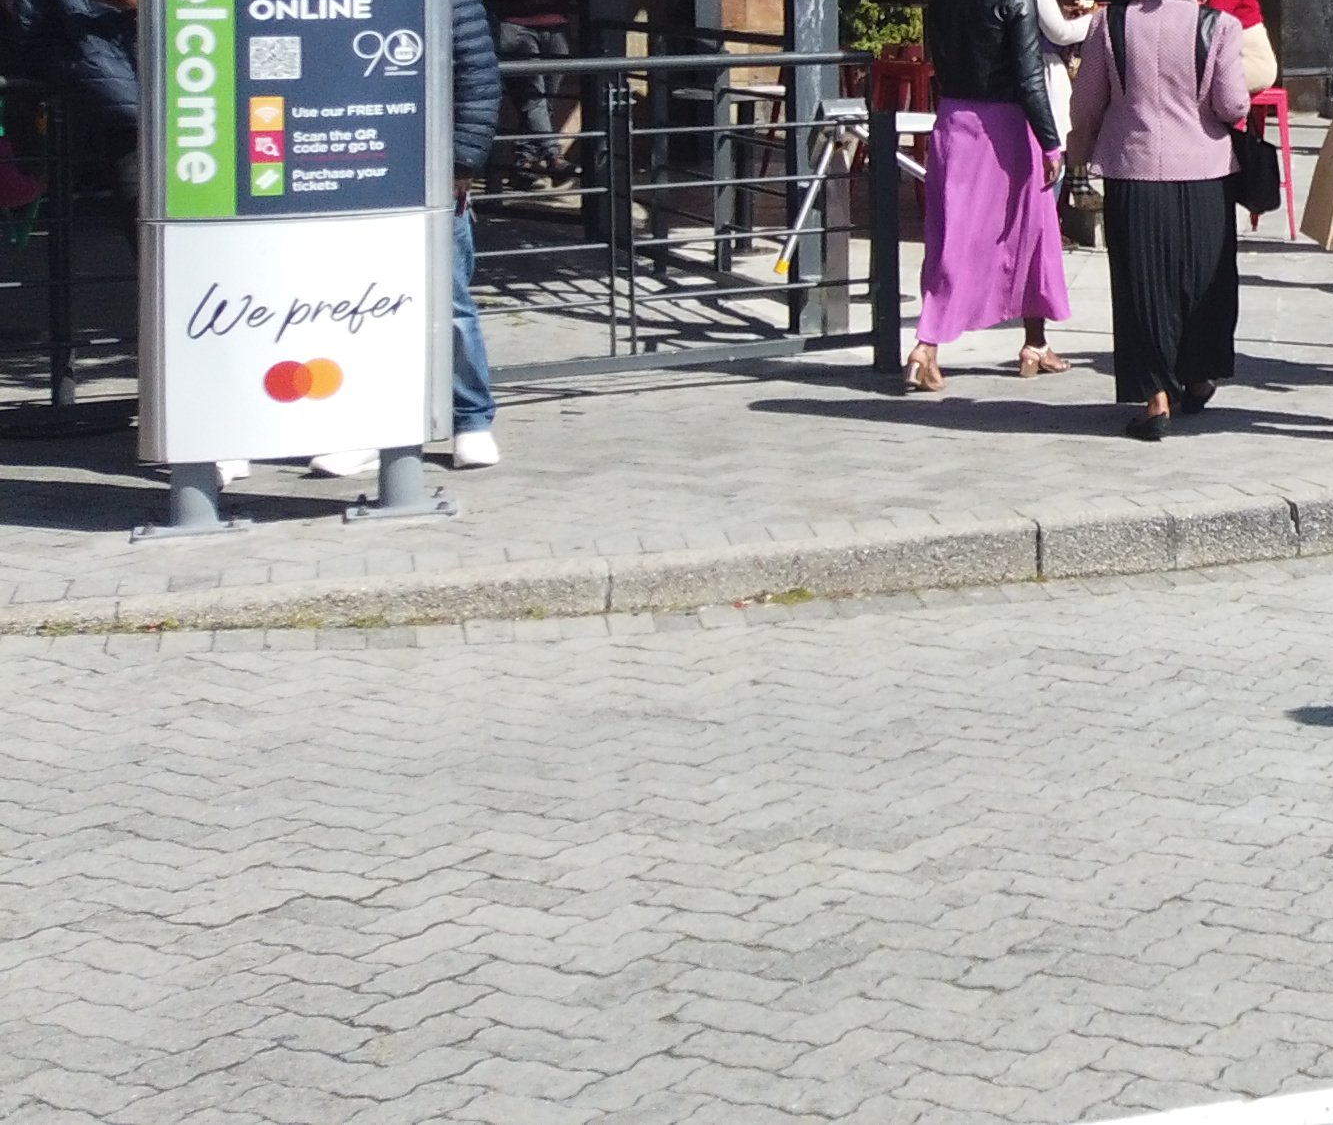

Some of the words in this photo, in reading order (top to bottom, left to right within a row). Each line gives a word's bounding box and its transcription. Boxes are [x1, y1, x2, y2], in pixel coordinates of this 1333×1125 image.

[292, 107, 319, 118] Use
[321, 107, 345, 117] our
[347, 104, 384, 116] FREE
[386, 102, 417, 115] WiFi
[293, 132, 327, 143] Scan
[330, 130, 352, 141] the
[355, 129, 378, 140] QR
[293, 143, 328, 154] code
[330, 143, 345, 152] or
[348, 143, 367, 153] go
[369, 140, 384, 150] to
[292, 168, 354, 180] Purchase
[357, 167, 388, 179] your
[292, 180, 339, 192] tickets
[187, 282, 275, 340] We
[275, 282, 413, 344] prefer
